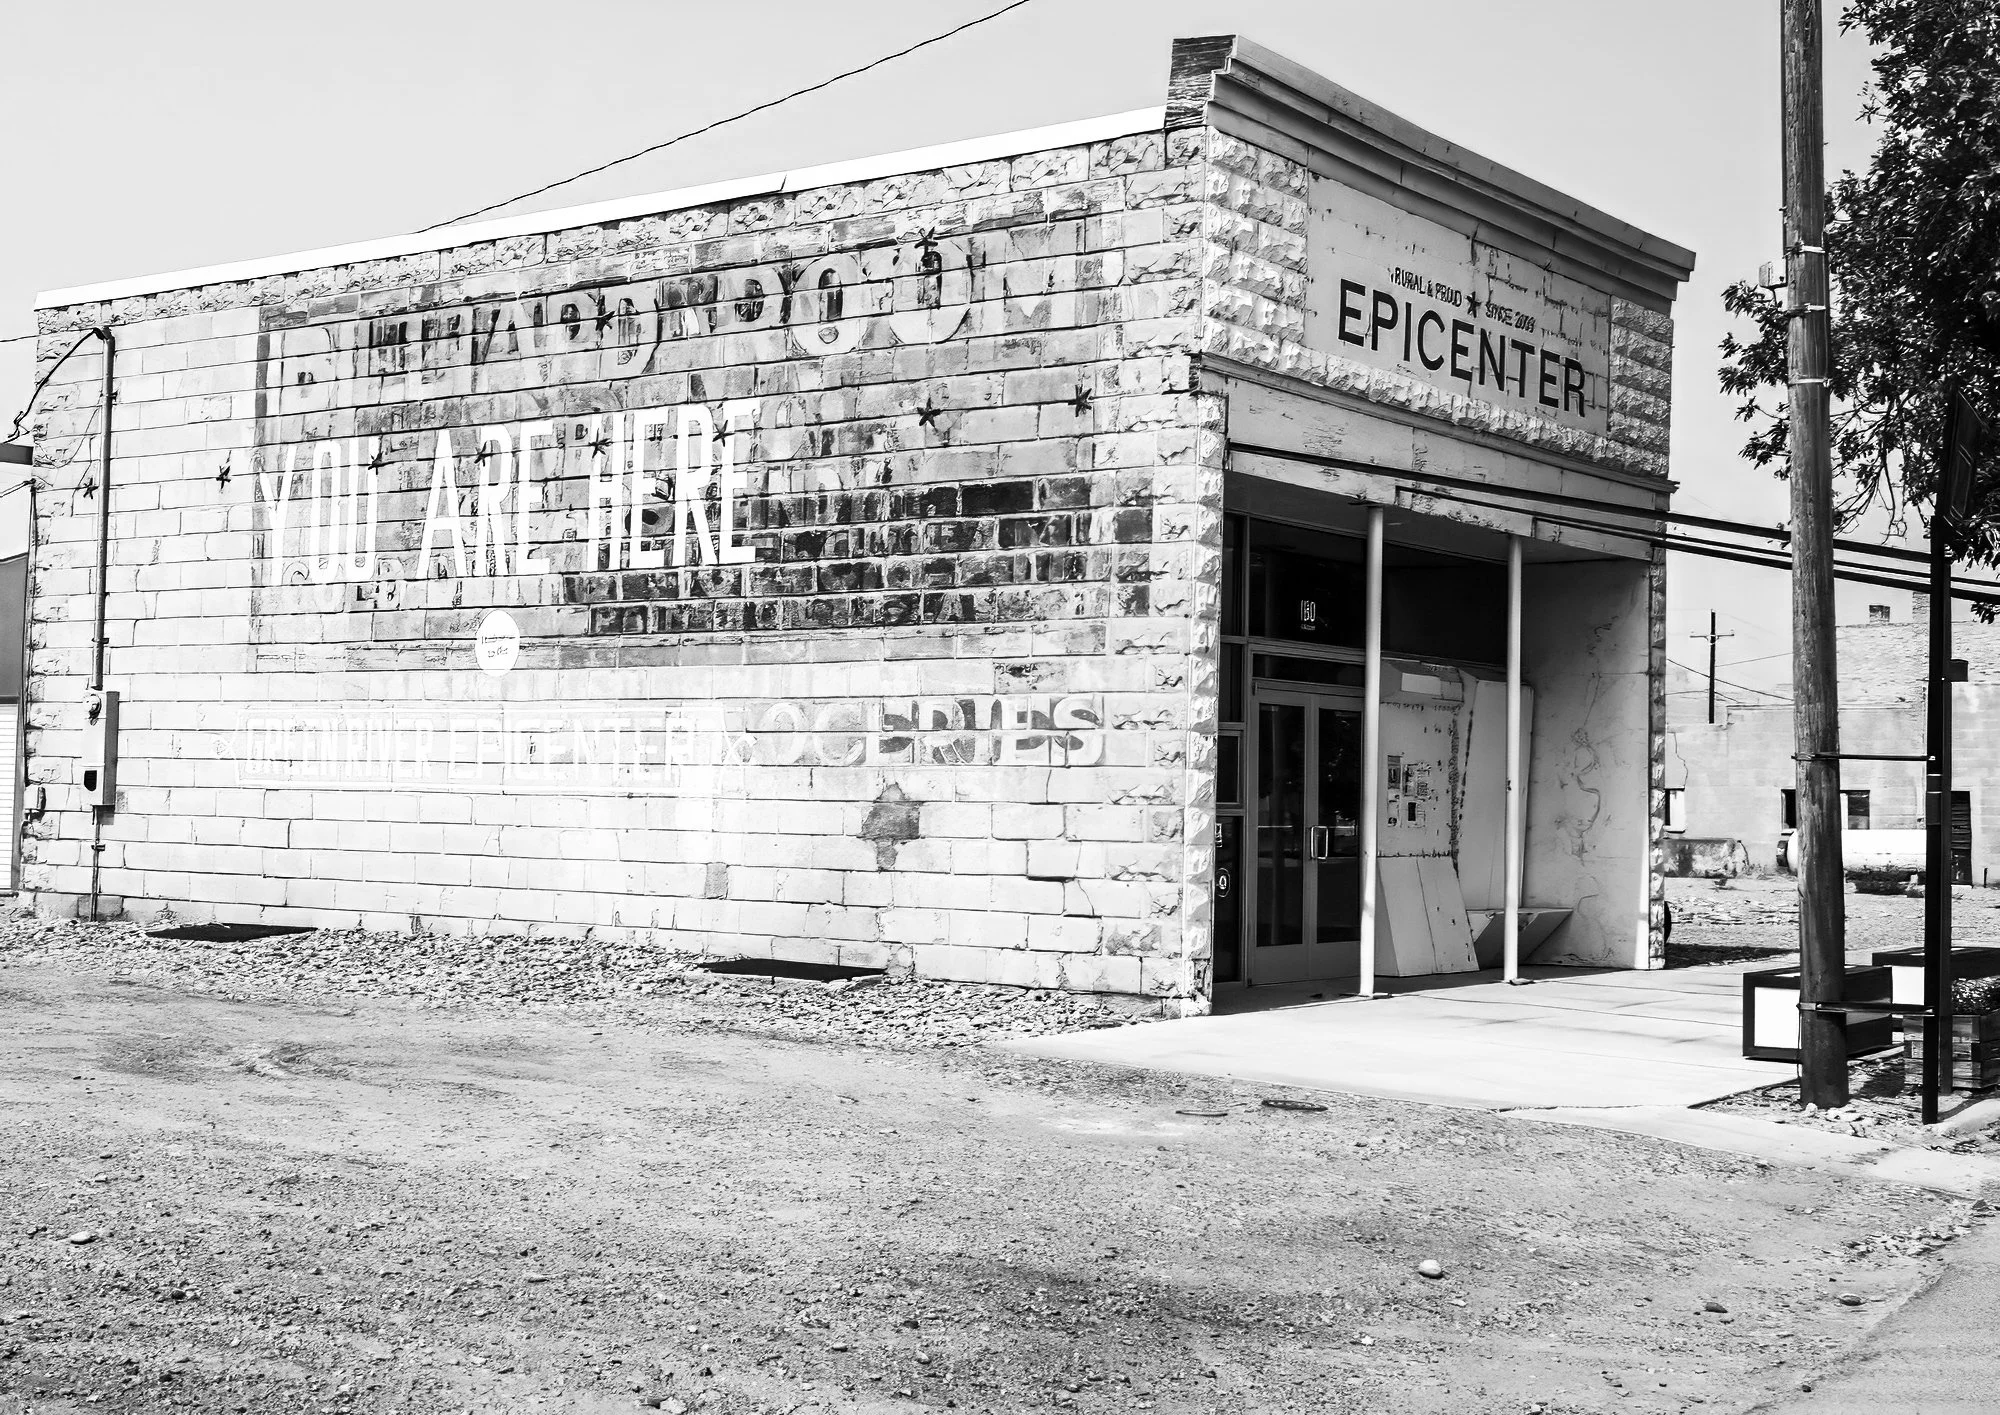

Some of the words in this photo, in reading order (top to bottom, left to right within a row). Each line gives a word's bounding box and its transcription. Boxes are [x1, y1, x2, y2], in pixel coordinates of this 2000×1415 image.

[1395, 267, 1425, 294] RURAL
[1435, 283, 1462, 307] PROUD
[1486, 302, 1513, 326] SINCE
[1338, 279, 1585, 417] EPICENTER
[257, 436, 382, 585] YOU
[416, 419, 553, 579] ARE
[588, 402, 761, 572] HERE
[245, 717, 339, 778] GREEN
[345, 716, 434, 780] RIVER
[448, 715, 695, 783] EPICENTER
